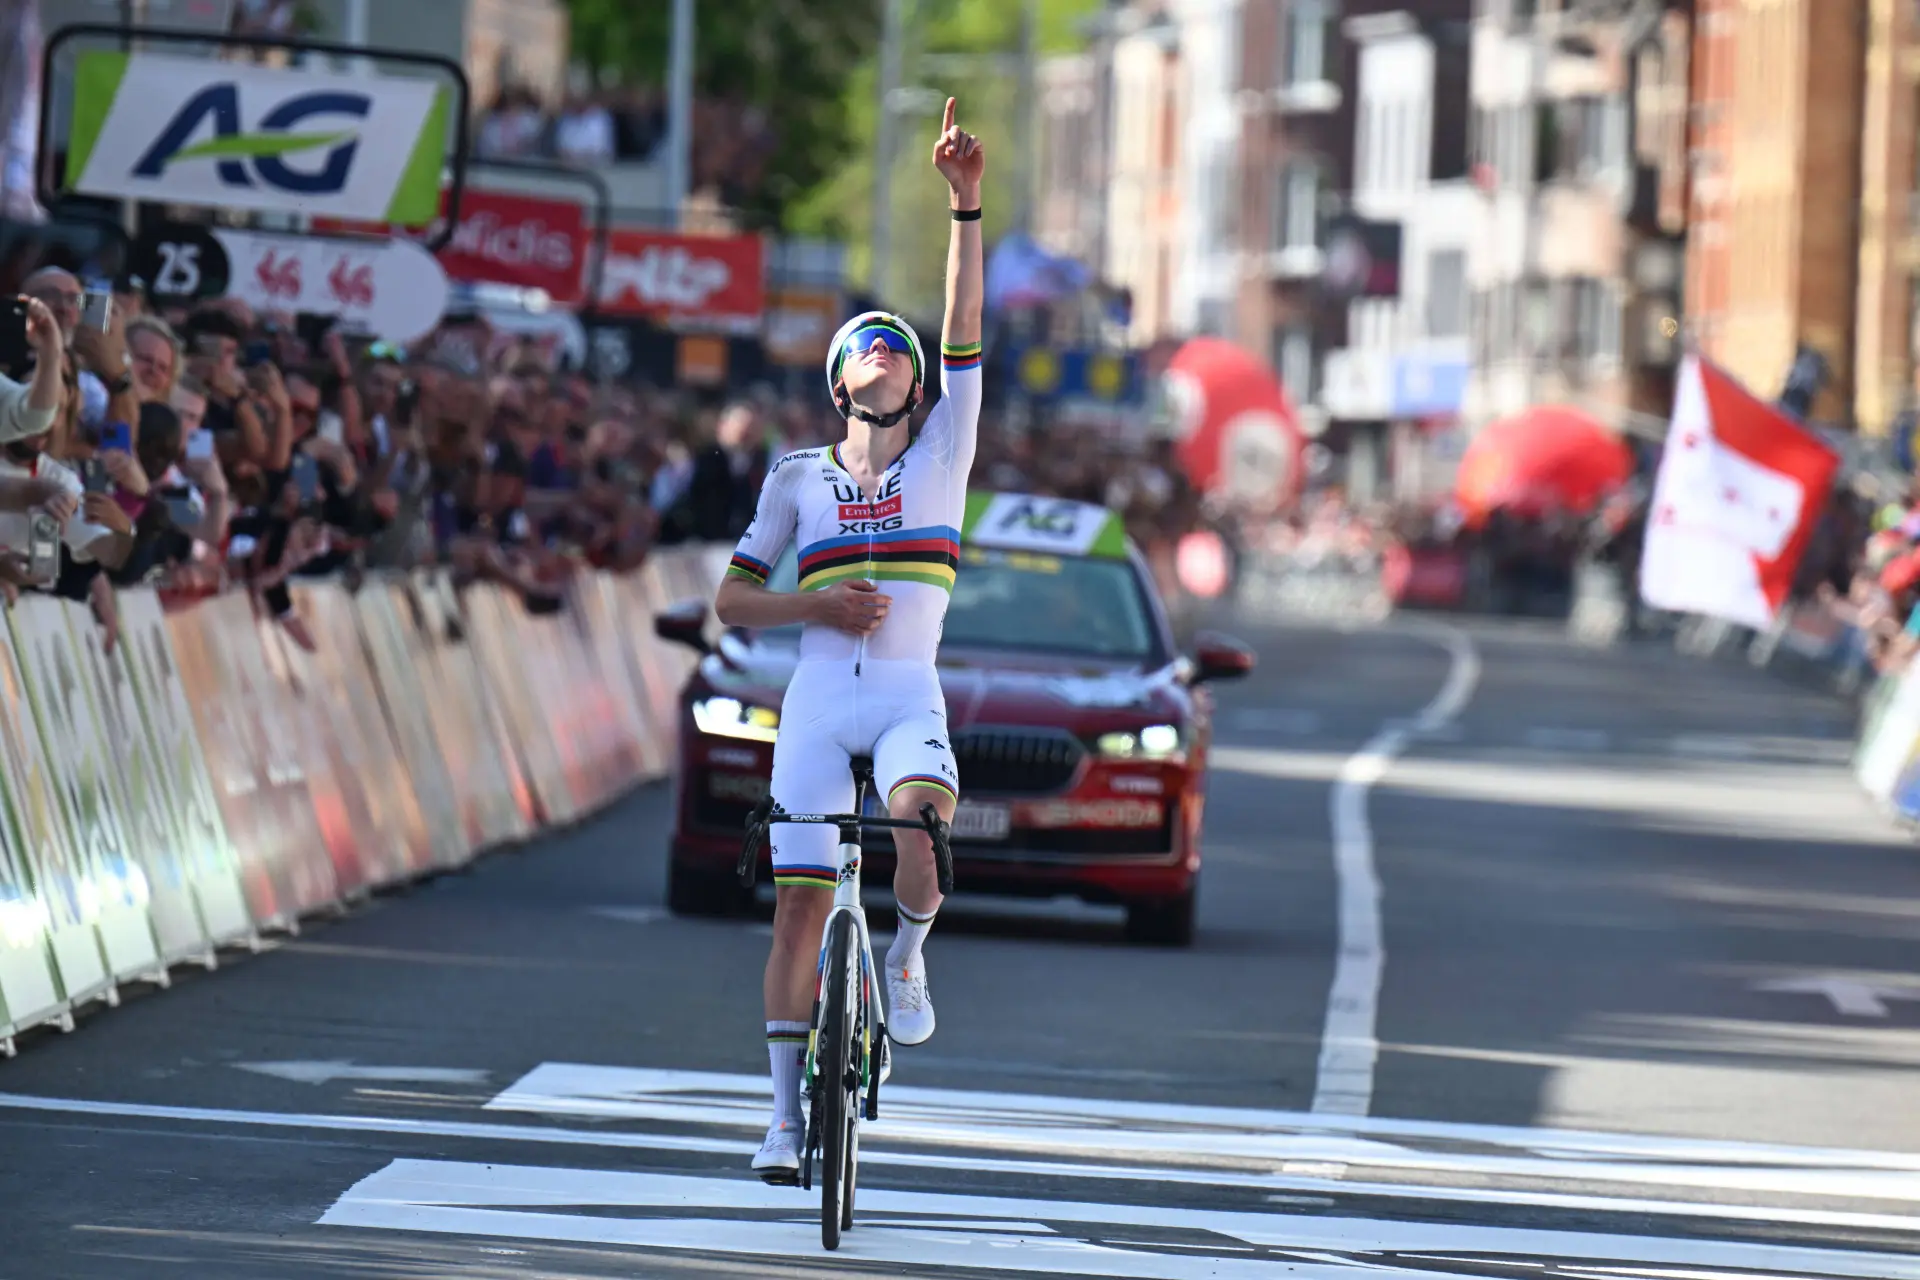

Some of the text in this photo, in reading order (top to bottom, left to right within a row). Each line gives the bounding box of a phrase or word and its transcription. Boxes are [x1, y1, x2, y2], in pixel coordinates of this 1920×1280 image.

[130, 81, 373, 194] AG
[153, 241, 200, 294] 25
[780, 452, 820, 464] Analog
[845, 503, 896, 516] Emiates
[839, 516, 903, 535] XRG
